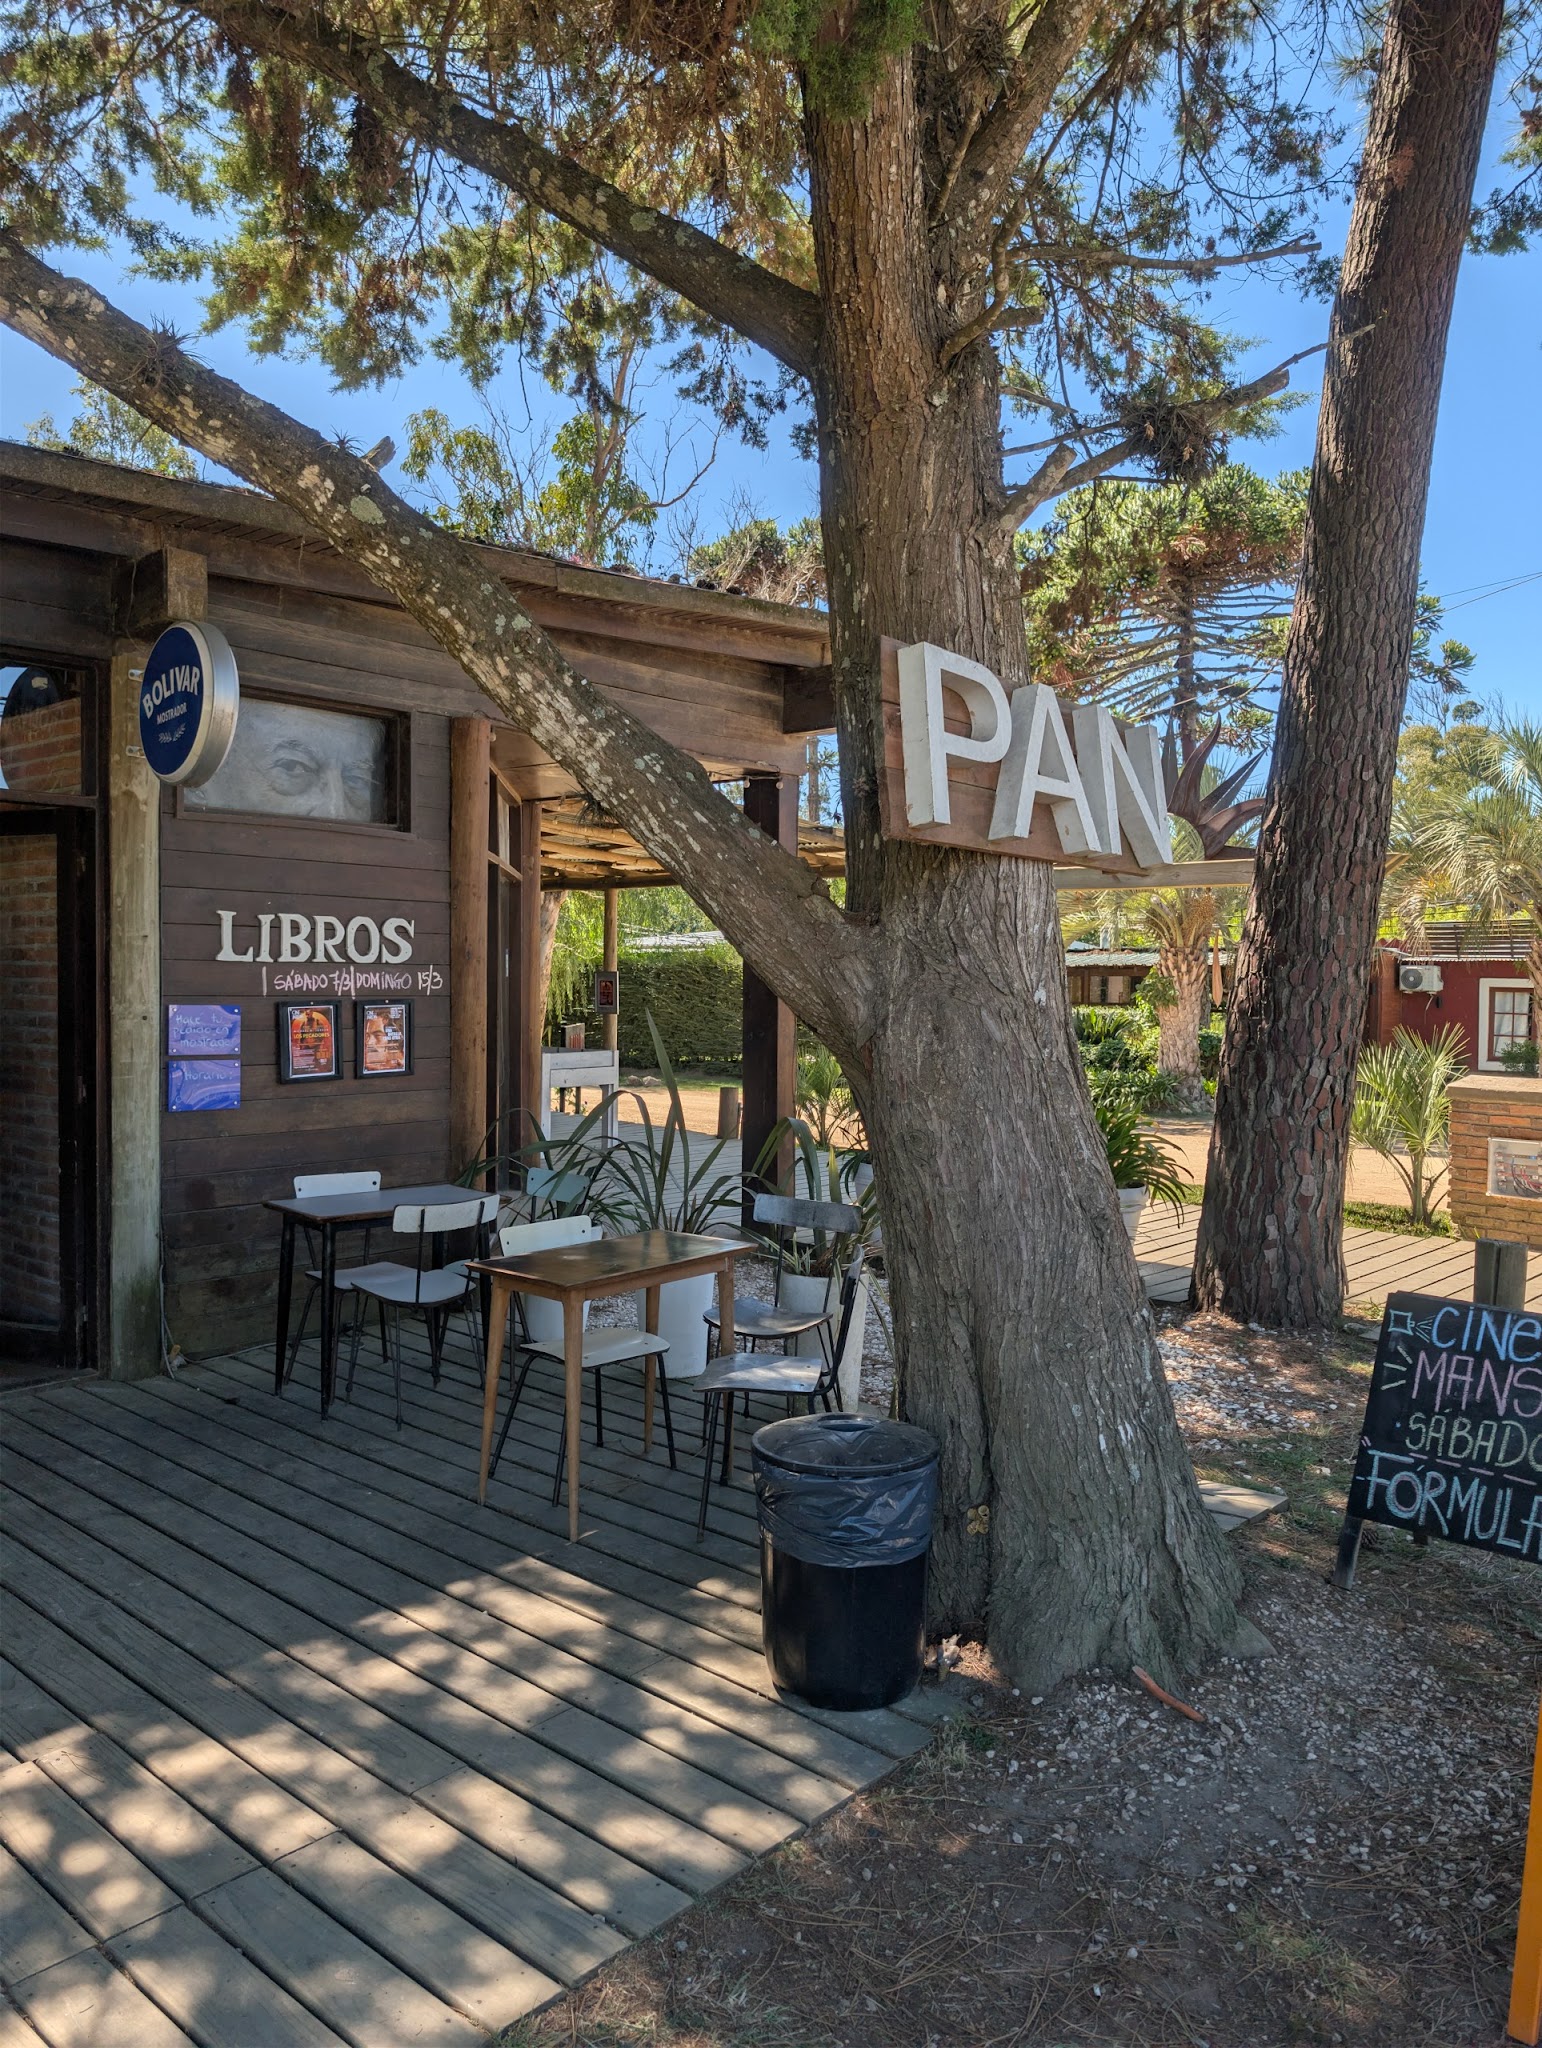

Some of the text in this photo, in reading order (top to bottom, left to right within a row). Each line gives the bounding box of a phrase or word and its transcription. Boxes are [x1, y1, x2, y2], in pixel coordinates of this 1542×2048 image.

[142, 664, 201, 720] BOLIVAR
[156, 702, 188, 725] MOSTRADOR
[898, 641, 1173, 870] PAN
[215, 909, 415, 964] LIBROS
[417, 964, 443, 996] 15/3
